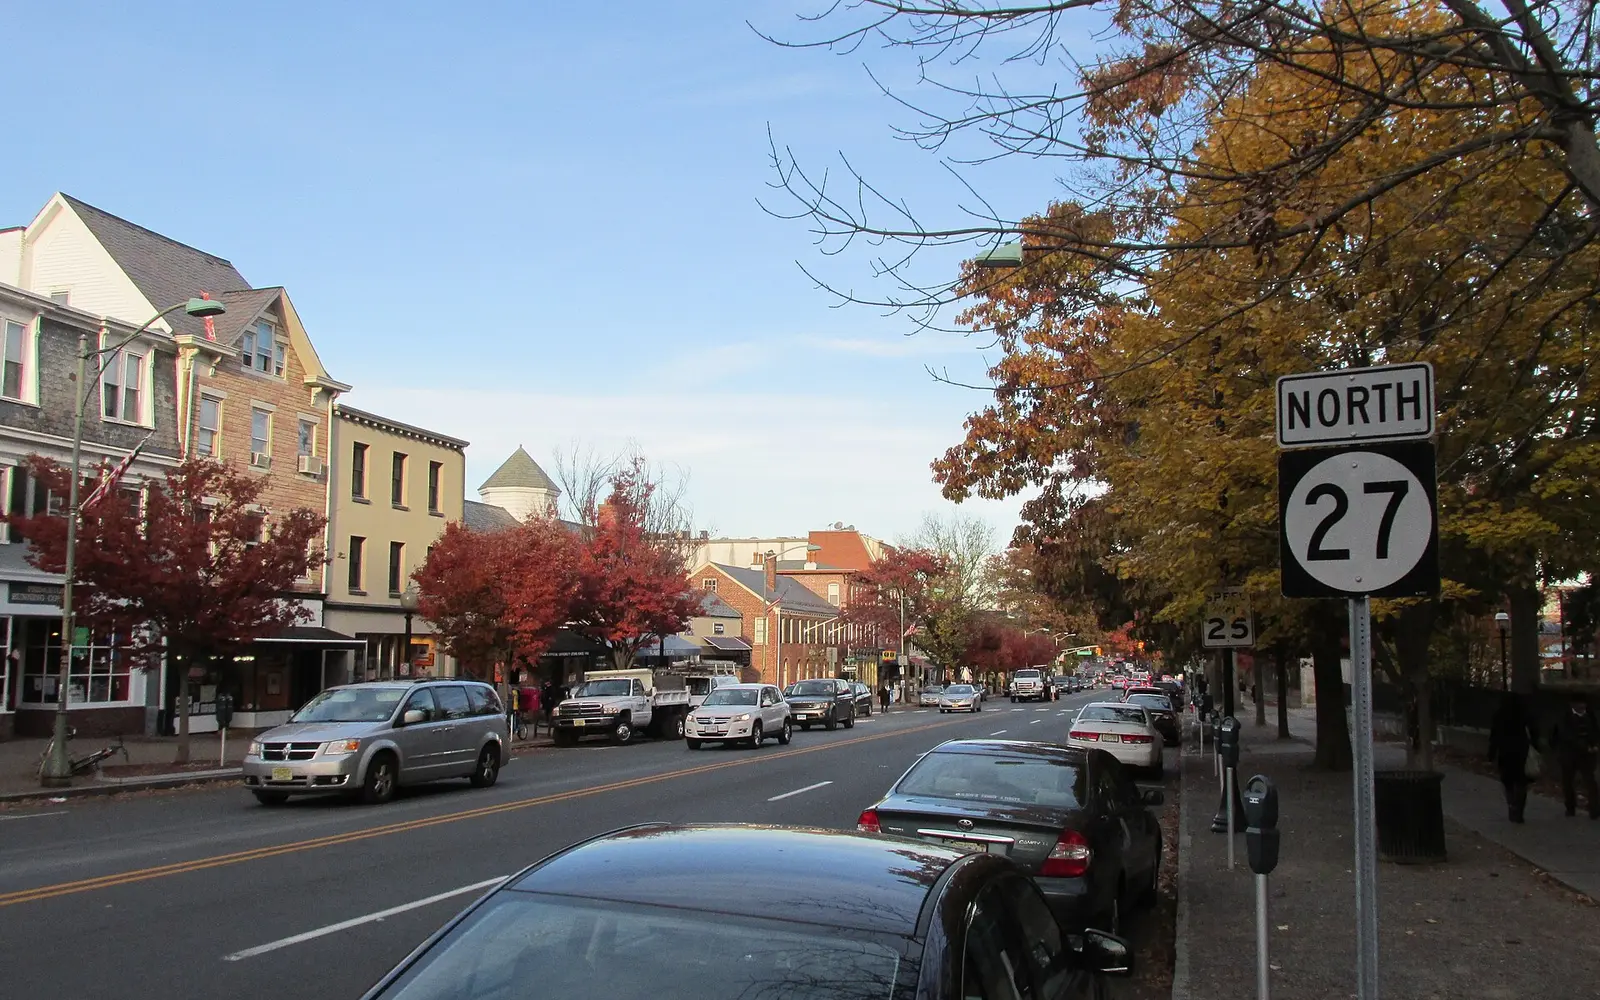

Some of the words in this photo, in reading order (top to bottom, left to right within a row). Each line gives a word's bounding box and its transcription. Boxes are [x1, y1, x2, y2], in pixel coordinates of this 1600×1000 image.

[1287, 379, 1422, 430] NORTH
[1304, 479, 1410, 562] 27
[1207, 617, 1249, 640] 25
